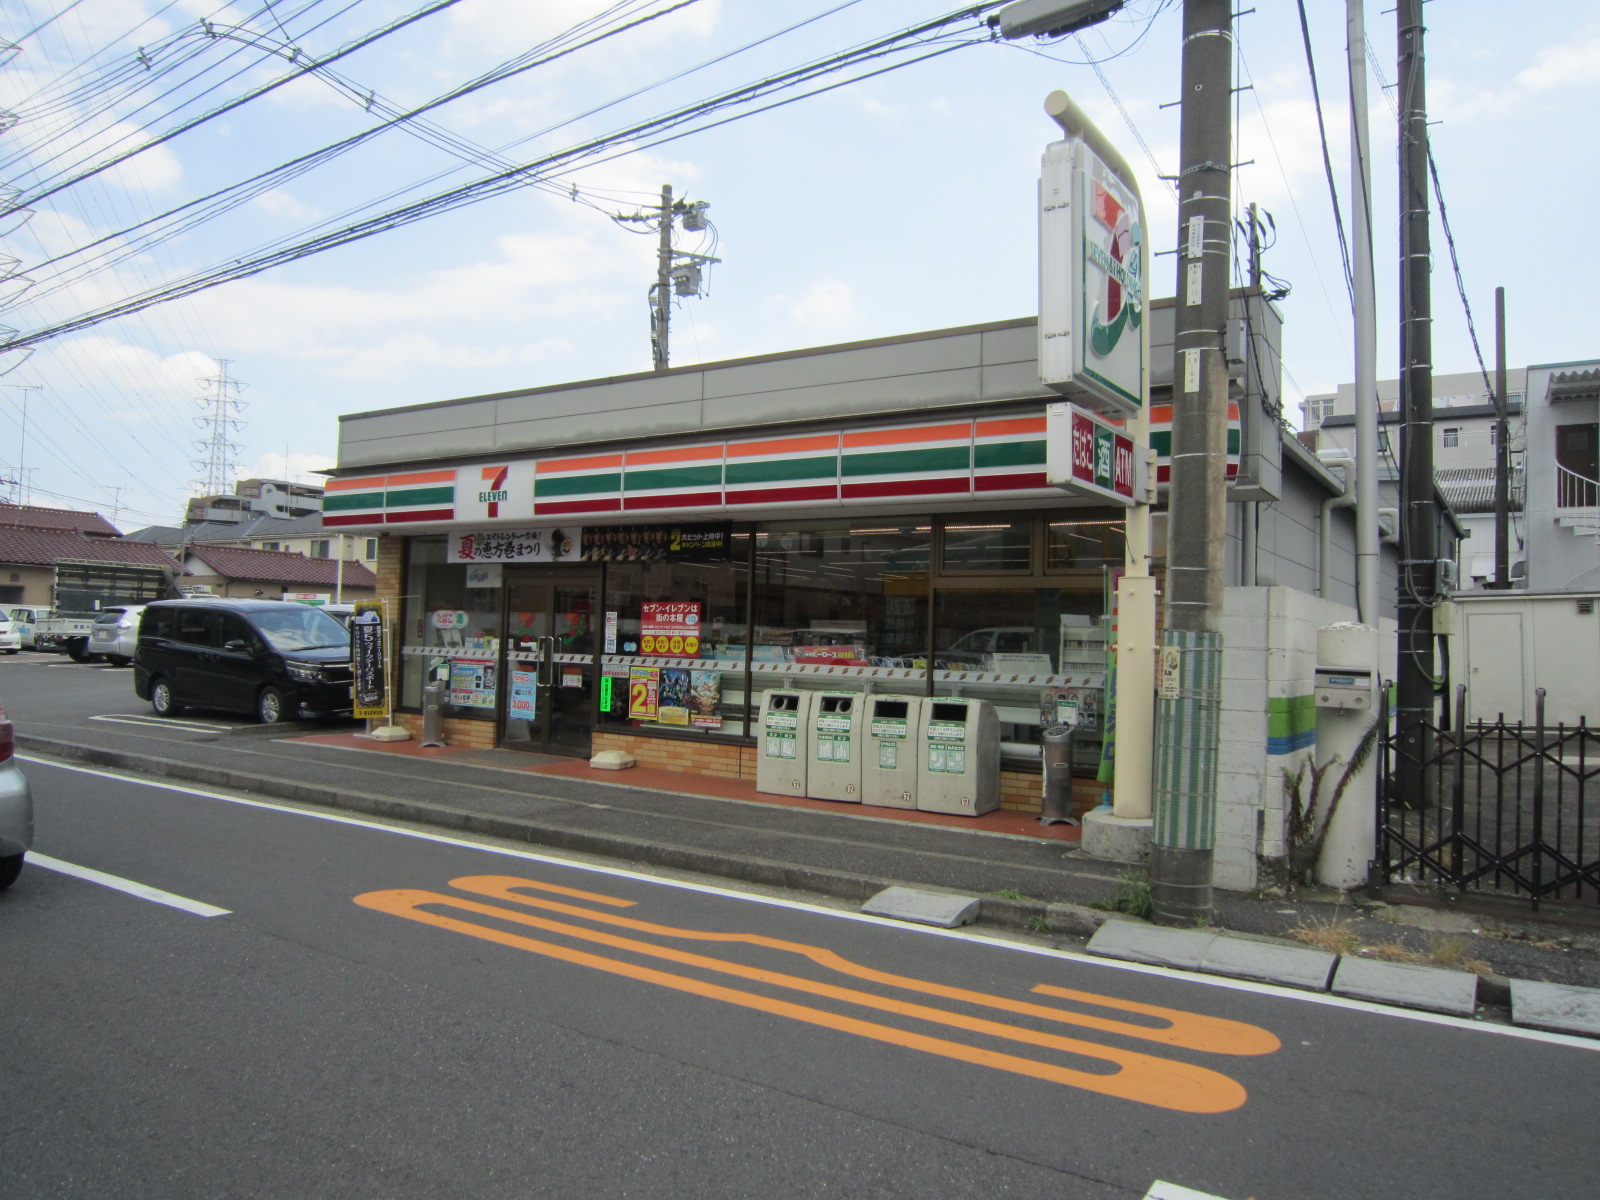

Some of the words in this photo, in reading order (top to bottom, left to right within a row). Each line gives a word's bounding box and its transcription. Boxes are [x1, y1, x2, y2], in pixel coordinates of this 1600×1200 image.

[1073, 425, 1093, 470] たばこ
[1098, 437, 1111, 478] 酒
[1116, 446, 1132, 487] ATM
[482, 466, 508, 518] 7
